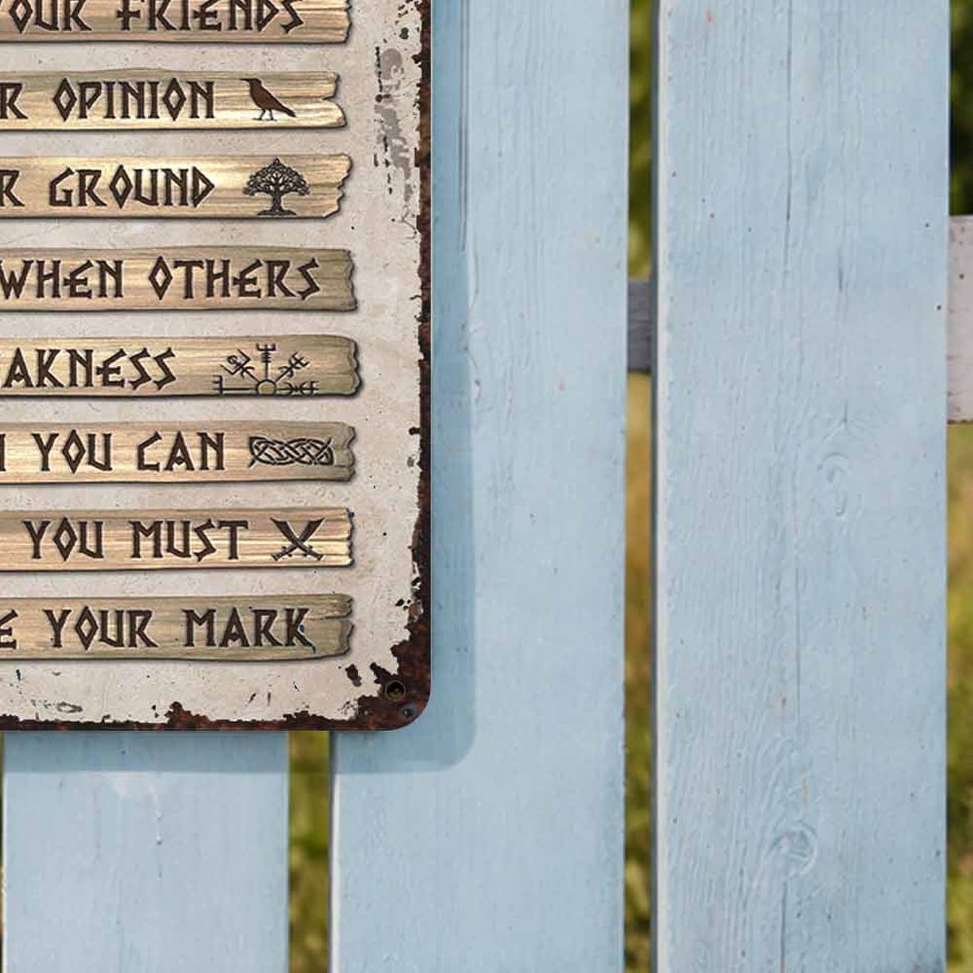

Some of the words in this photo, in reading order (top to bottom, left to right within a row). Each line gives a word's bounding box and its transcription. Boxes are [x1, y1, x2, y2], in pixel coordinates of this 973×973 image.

[53, 79, 215, 122] OPINION
[49, 165, 215, 210] GROUND
[148, 256, 321, 301] OTHERS
[33, 430, 114, 474] YOU
[137, 430, 225, 474] CAN
[23, 517, 104, 562] YOU
[130, 517, 249, 562] MUST
[42, 605, 153, 651] YOUR
[182, 605, 313, 651] MARK
